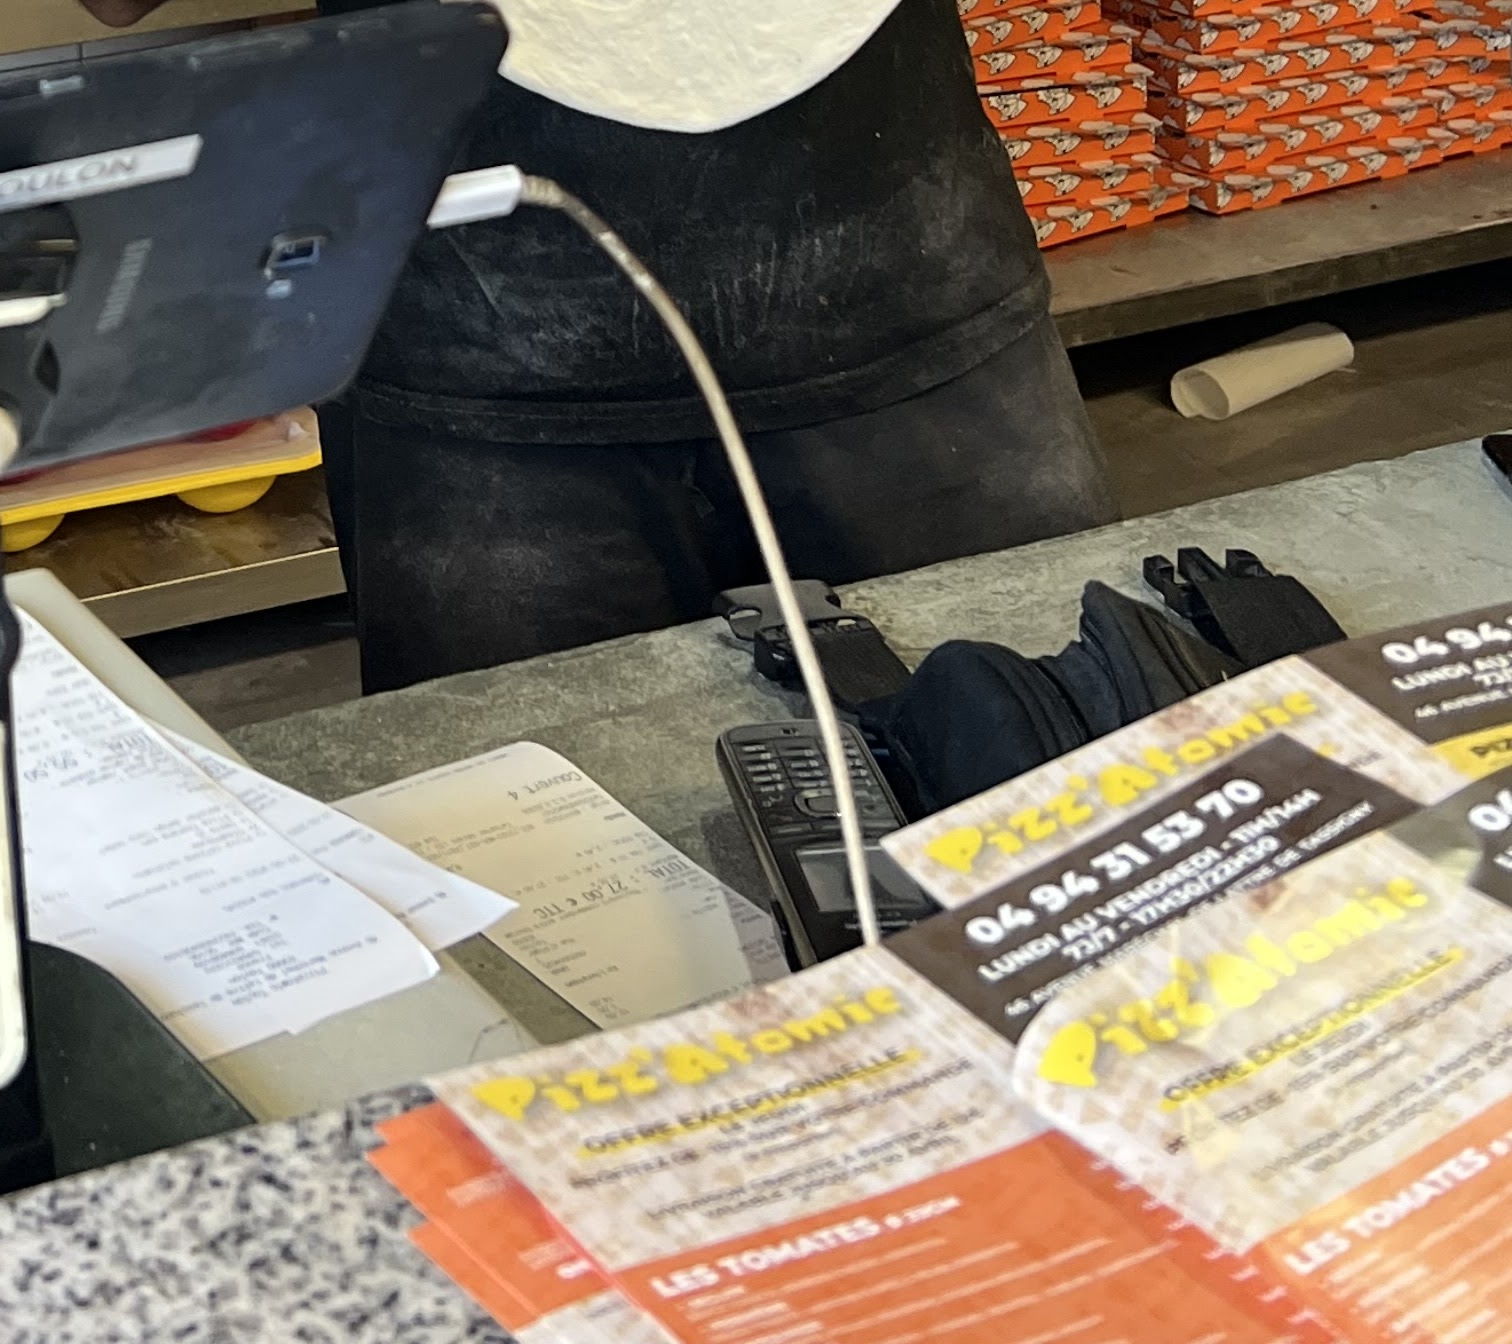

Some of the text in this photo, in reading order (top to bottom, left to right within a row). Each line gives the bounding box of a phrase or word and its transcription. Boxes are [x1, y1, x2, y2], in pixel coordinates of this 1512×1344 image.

[924, 690, 1318, 874] Pizz'Atomic
[965, 778, 1264, 946] 04 94 31 53 70
[976, 936, 1060, 983] LUNDI
[1059, 914, 1101, 944] AU
[1099, 846, 1222, 924] VENDREDI
[470, 987, 902, 1120] Pizz'Atomic
[651, 1263, 720, 1299] LES
[716, 1214, 883, 1278] TOMATES
[1285, 1232, 1354, 1276] LES
[1344, 1145, 1491, 1238] TOMATES
